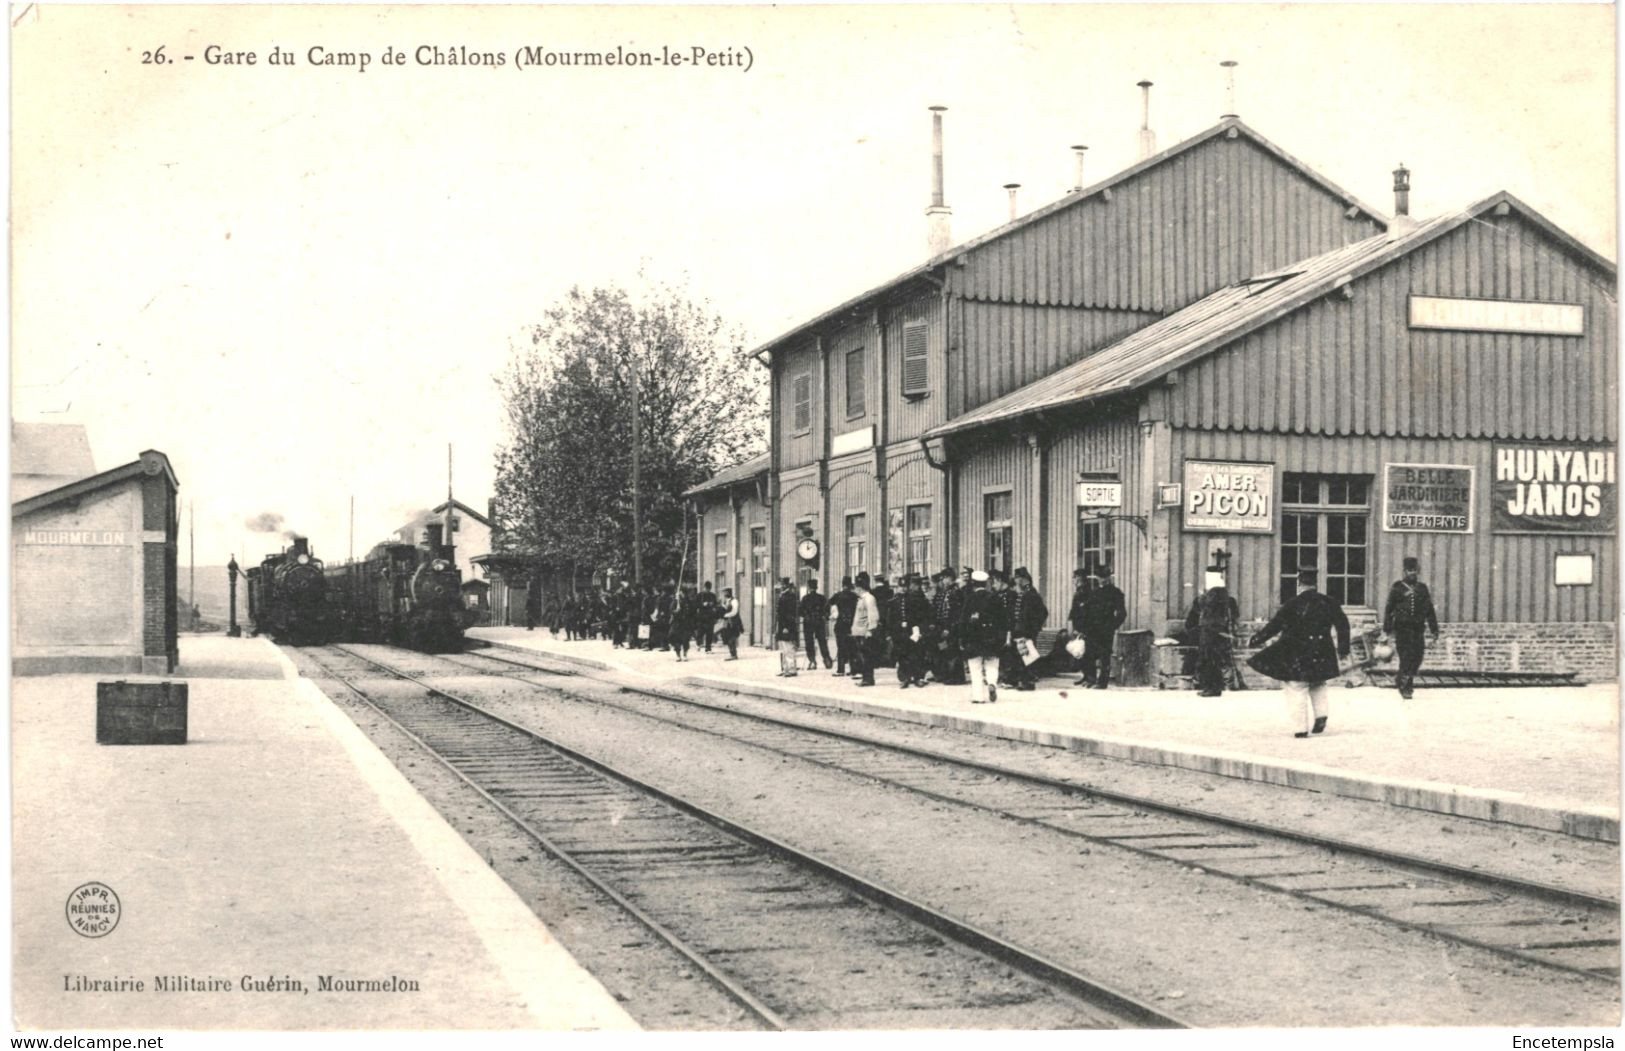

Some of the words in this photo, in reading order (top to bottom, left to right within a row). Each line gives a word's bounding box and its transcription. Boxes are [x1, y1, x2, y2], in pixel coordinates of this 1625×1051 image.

[1496, 448, 1616, 484] HUNYADI
[1201, 472, 1258, 492] AMER
[1405, 468, 1455, 485] BELLE
[1086, 487, 1116, 502] SORTIE
[1189, 490, 1269, 517] PICON
[24, 531, 124, 545] MOURMELON
